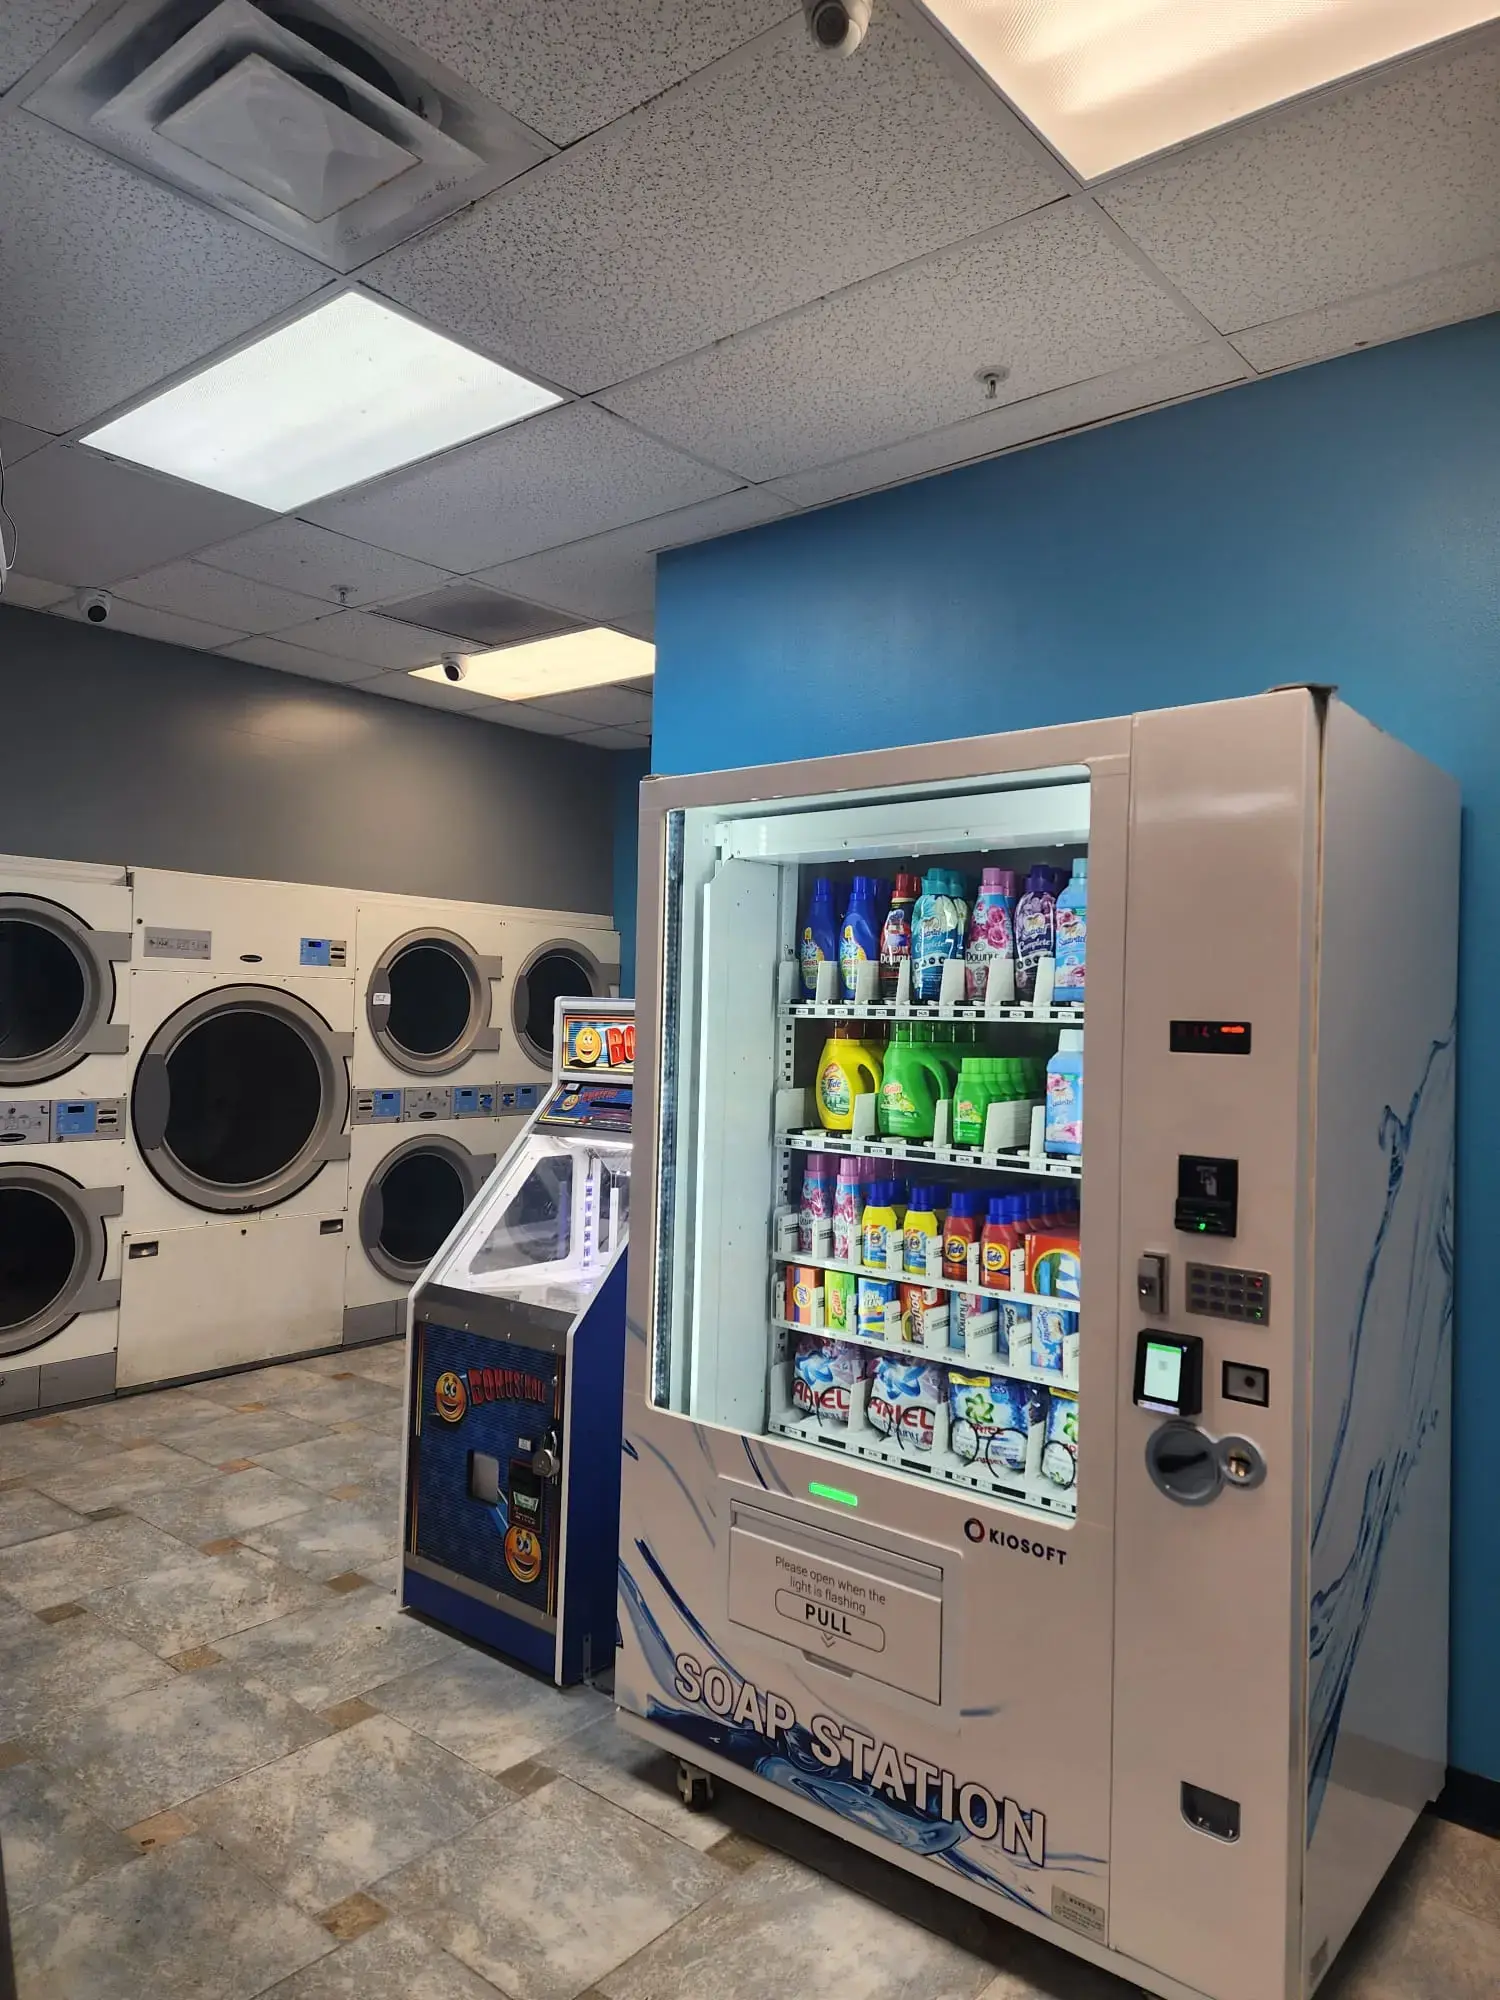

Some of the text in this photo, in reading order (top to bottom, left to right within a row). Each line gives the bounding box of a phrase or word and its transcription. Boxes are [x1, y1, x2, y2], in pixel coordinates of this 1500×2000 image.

[827, 1078, 841, 1089] Tide
[946, 1241, 965, 1255] Tide
[986, 1250, 1002, 1263] Tide
[796, 1284, 807, 1305] Tide
[989, 1528, 1066, 1565] KIOSOFT
[775, 1556, 886, 1605] Please open when the
[790, 1576, 866, 1616] light is flashing
[805, 1603, 852, 1636] PULL
[675, 1653, 1046, 1868] SOAP STATION
